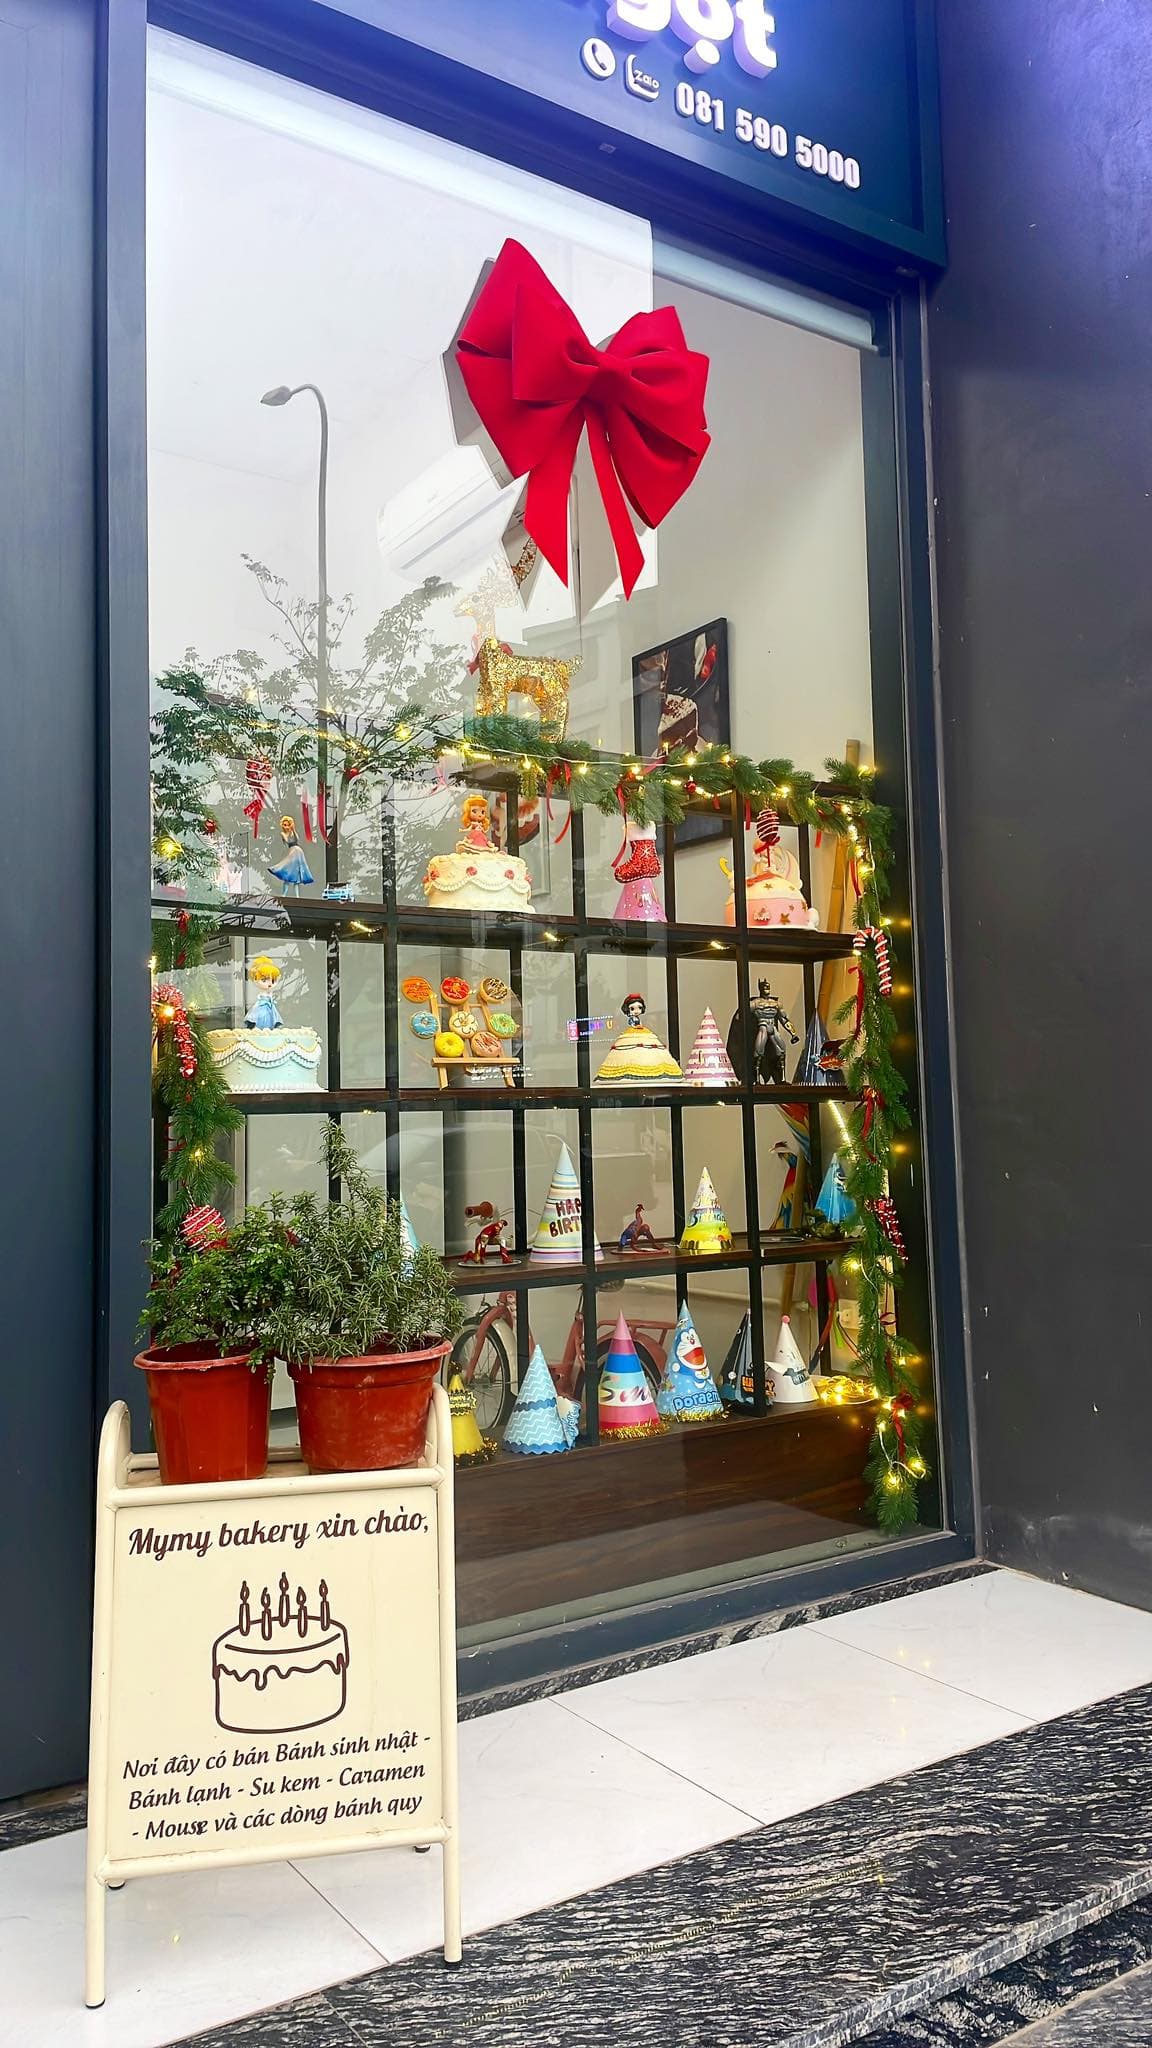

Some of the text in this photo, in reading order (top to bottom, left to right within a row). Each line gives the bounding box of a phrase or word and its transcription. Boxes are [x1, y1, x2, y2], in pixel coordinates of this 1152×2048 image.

[676, 82, 725, 132] 081
[736, 108, 788, 157] 590
[795, 135, 860, 189] 5000
[549, 1216, 580, 1237] BIRT
[555, 1198, 581, 1217] HAP
[673, 1390, 721, 1411] Doraem
[128, 1505, 429, 1562] Mymy bakery xin chào,
[122, 1757, 159, 1780] Nơi
[163, 1754, 201, 1777] đây
[205, 1749, 227, 1770] có
[231, 1746, 270, 1767] bán
[275, 1740, 326, 1763] Bánh
[329, 1736, 370, 1757] sinh
[374, 1730, 419, 1754] nhật
[128, 1787, 182, 1810] Bánh
[186, 1782, 232, 1807] lạnh
[249, 1777, 276, 1797] Su
[279, 1775, 321, 1794] kem
[339, 1764, 426, 1787] Caramen
[214, 1811, 238, 1832] và
[242, 1808, 276, 1829] các
[280, 1804, 329, 1825] dòng
[333, 1796, 384, 1819] bánh
[387, 1795, 423, 1816] quy
